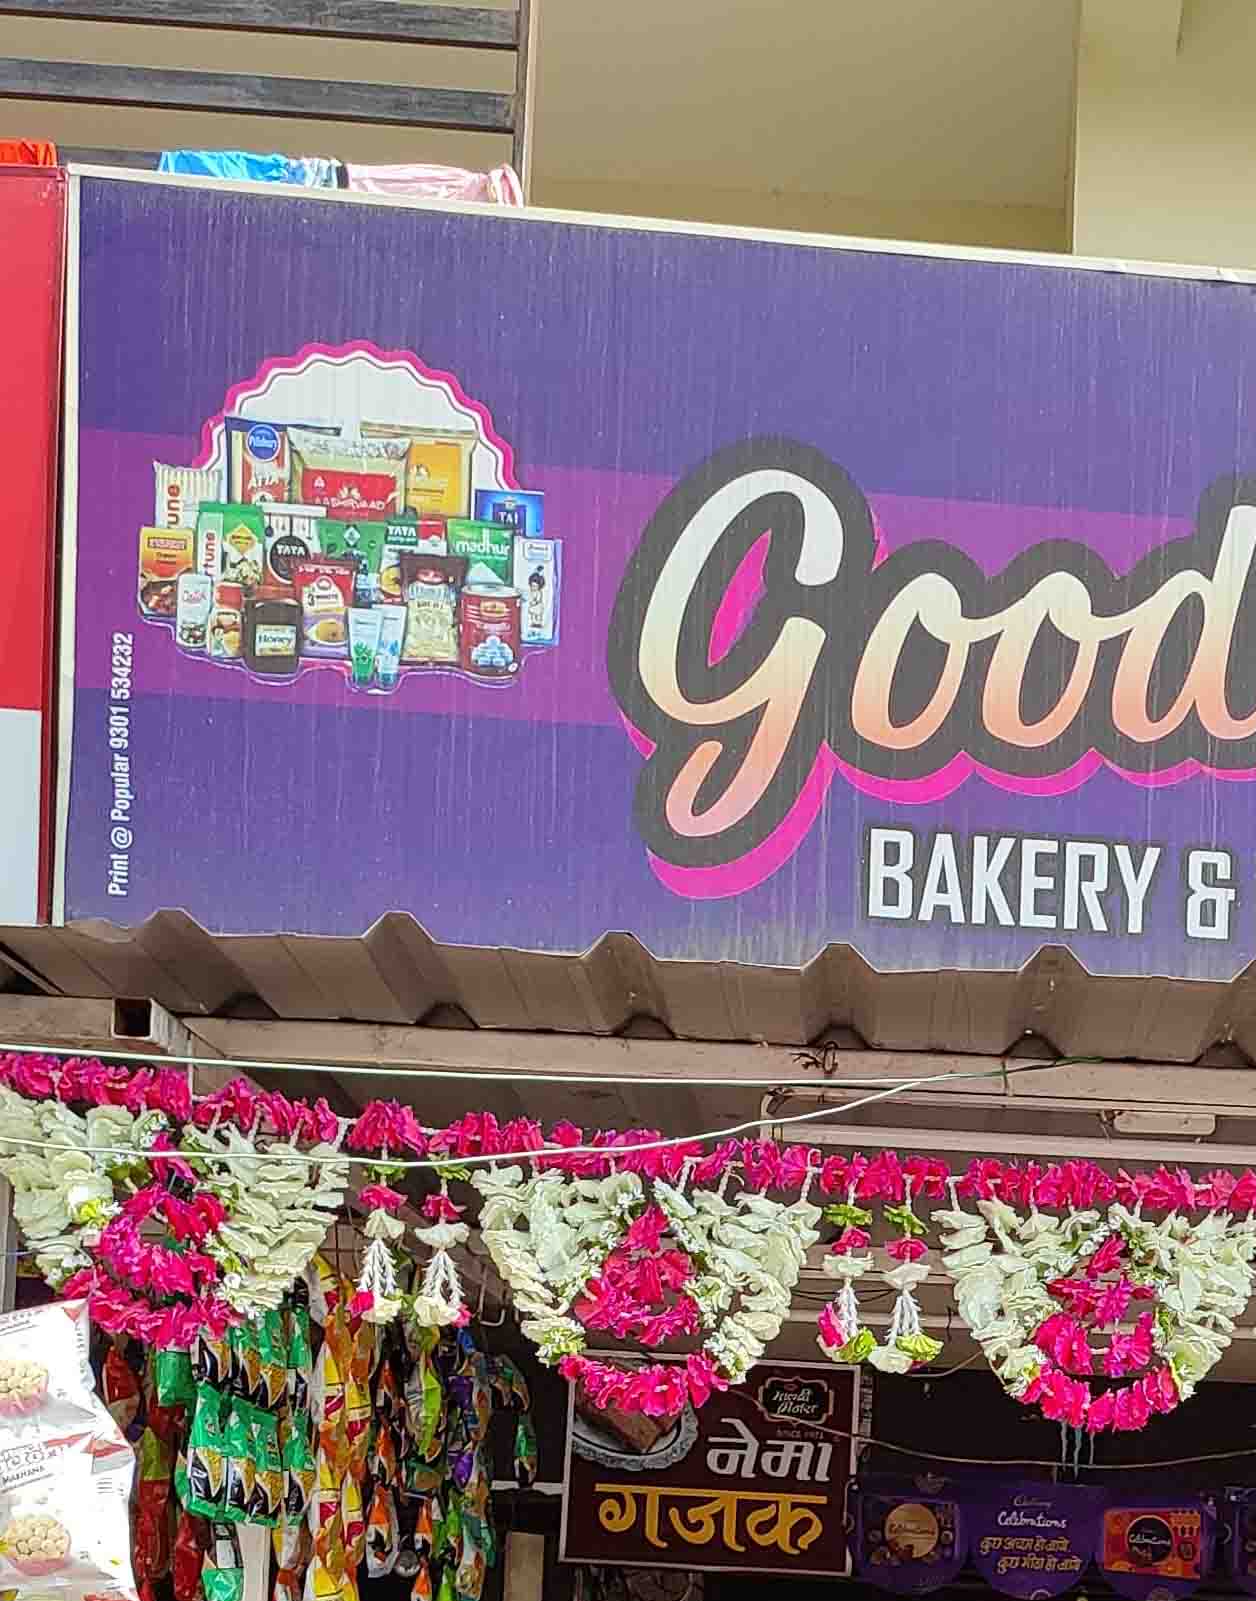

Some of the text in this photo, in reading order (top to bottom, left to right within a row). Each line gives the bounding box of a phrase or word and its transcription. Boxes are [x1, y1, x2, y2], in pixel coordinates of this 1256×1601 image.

[108, 632, 135, 896] Print @ Popular 9301 534232
[868, 827, 1161, 934] BAKERY
[1186, 850, 1236, 940] &
[706, 1418, 832, 1482] नेमा
[595, 1483, 828, 1555] गजक
